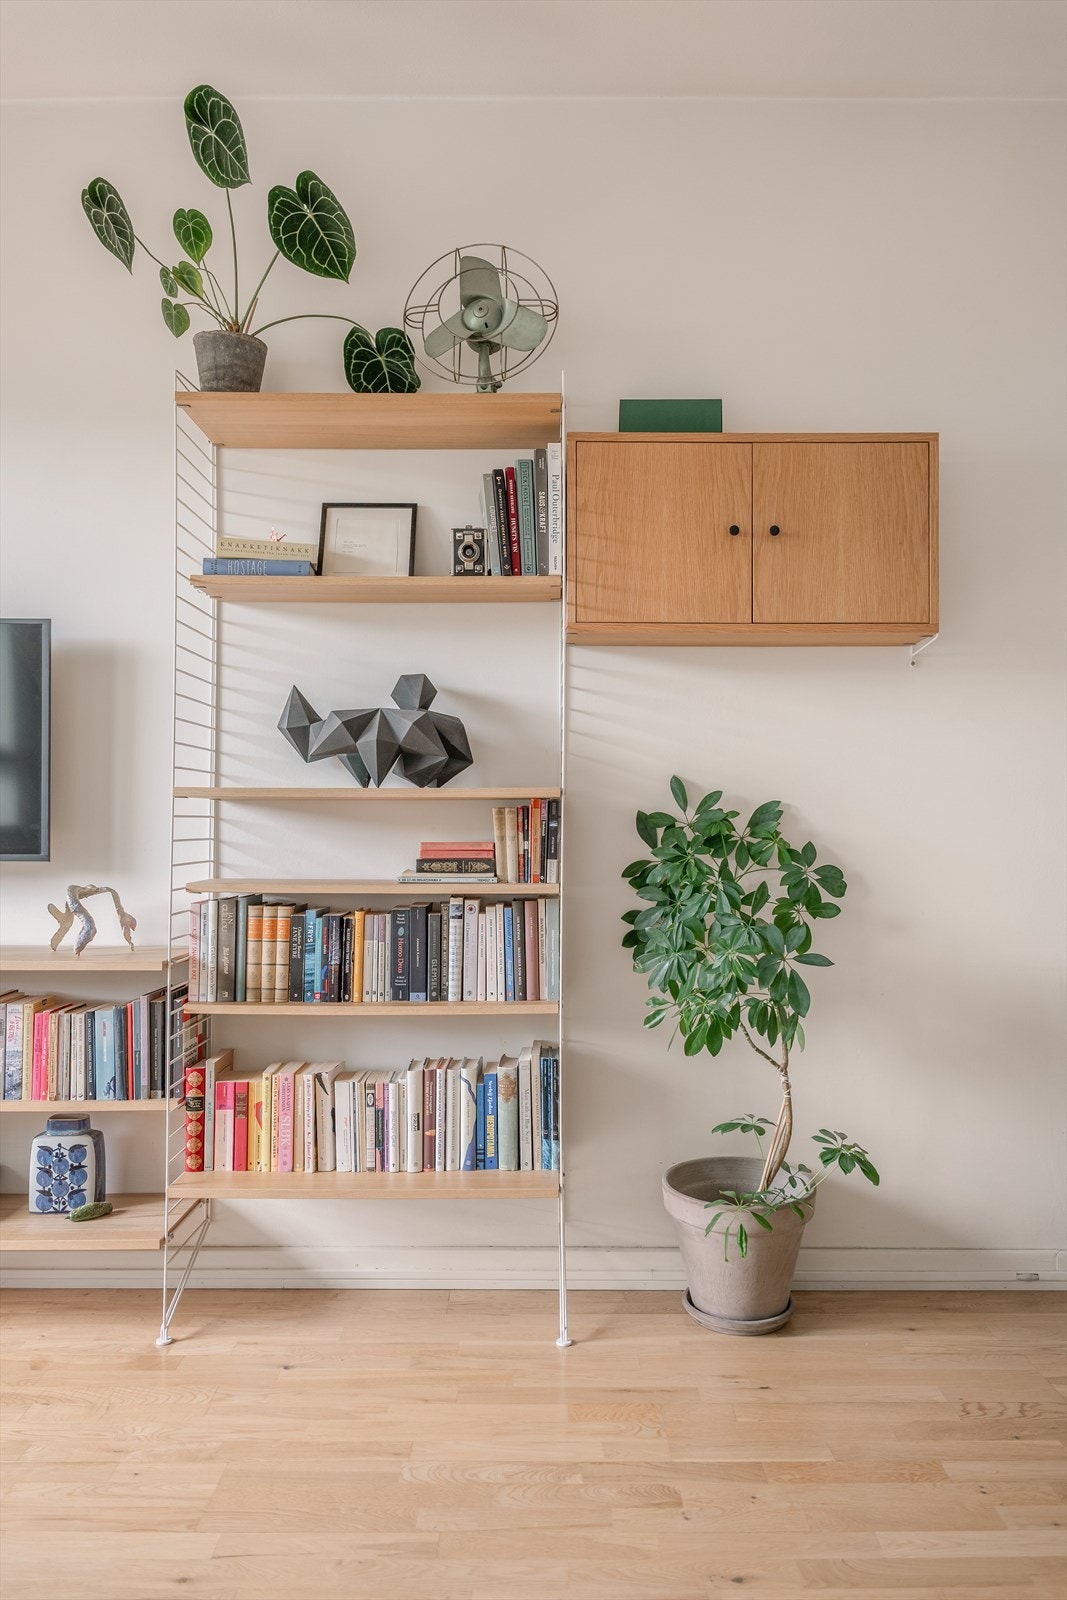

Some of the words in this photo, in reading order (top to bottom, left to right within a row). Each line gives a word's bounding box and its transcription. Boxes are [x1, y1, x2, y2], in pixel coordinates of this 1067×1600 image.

[550, 494, 560, 544] Outerbridge
[220, 541, 310, 554] KNAKKETIKNAKK
[227, 560, 268, 576] HOSTAGE
[280, 1116, 291, 1145] SLUK
[486, 1115, 495, 1158] MESOPOTAMIA
